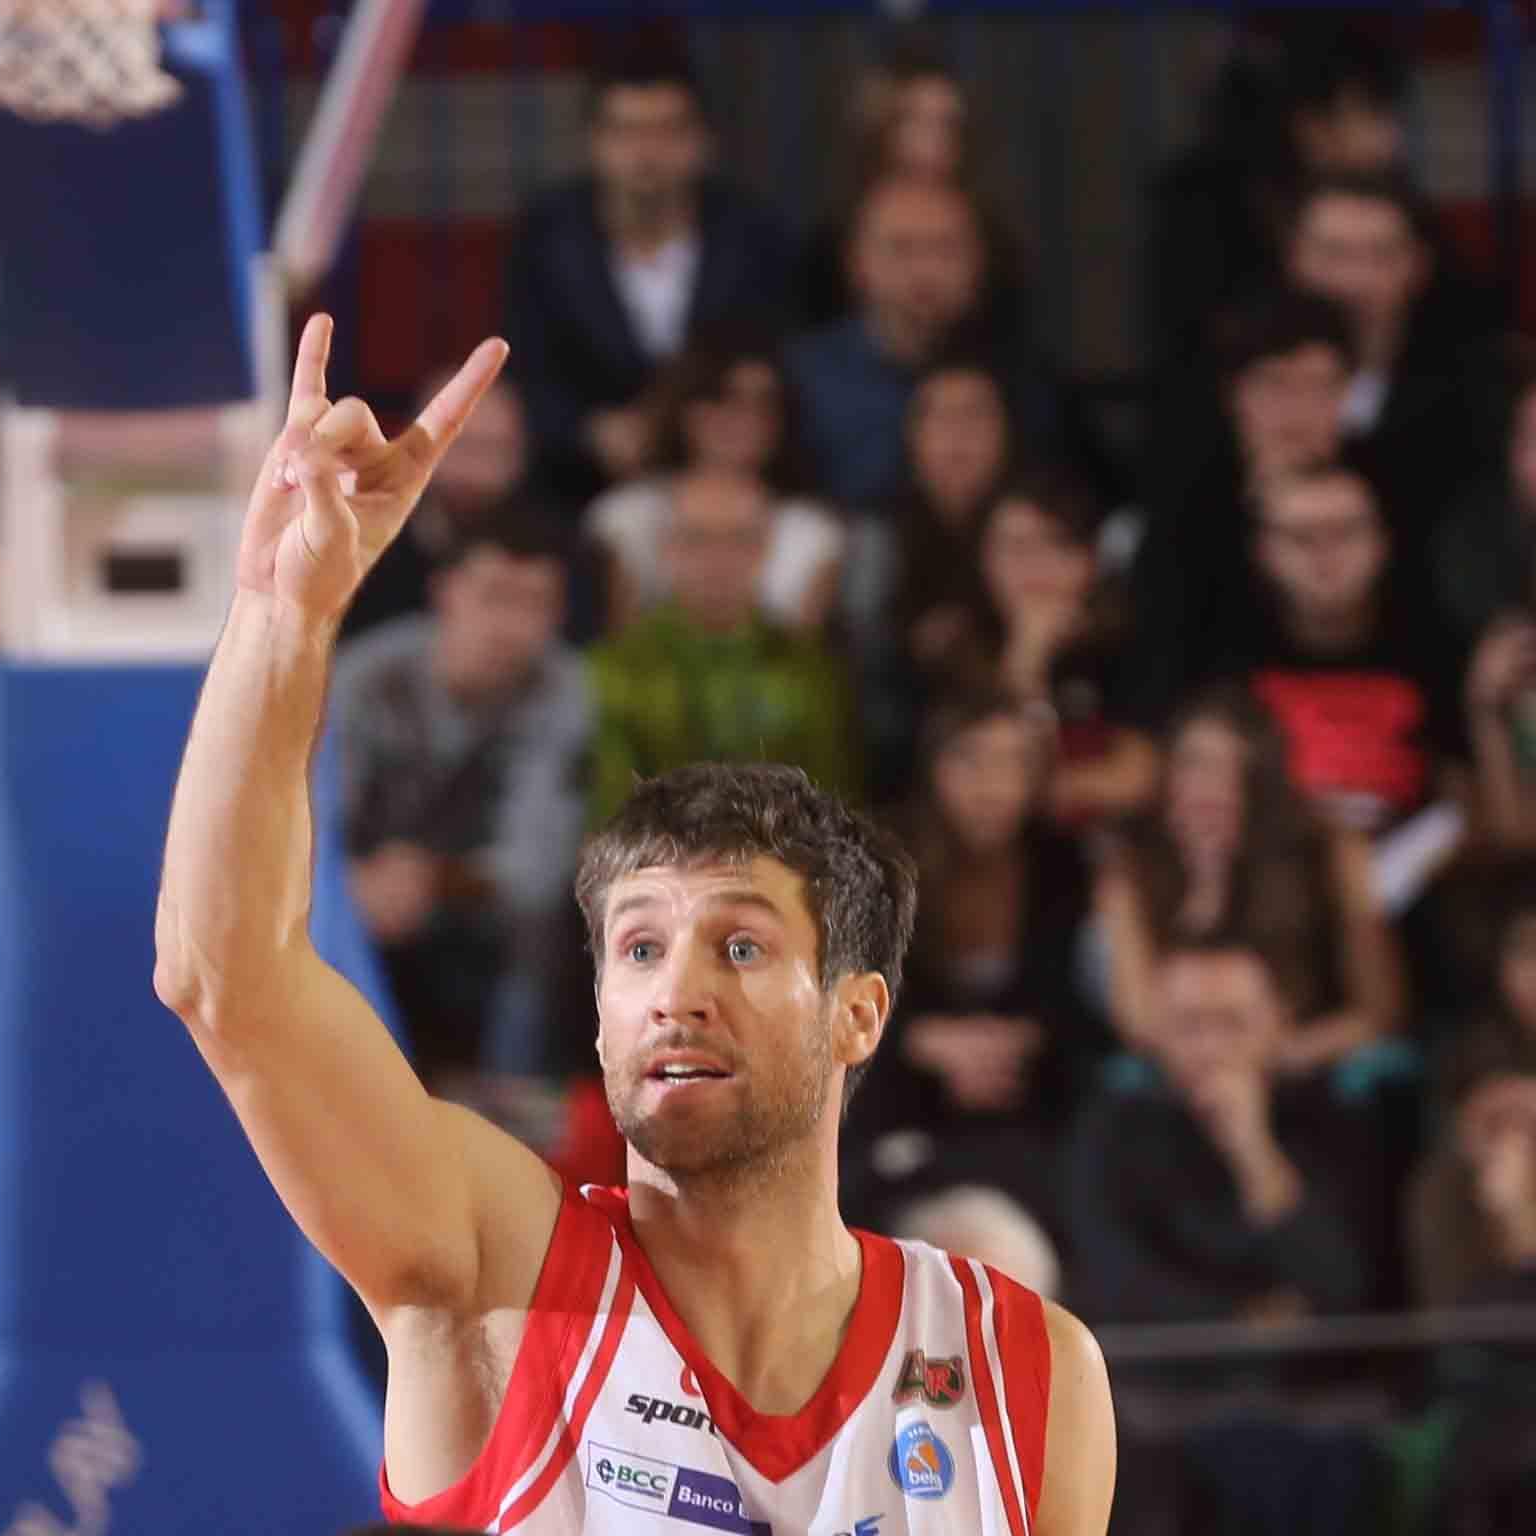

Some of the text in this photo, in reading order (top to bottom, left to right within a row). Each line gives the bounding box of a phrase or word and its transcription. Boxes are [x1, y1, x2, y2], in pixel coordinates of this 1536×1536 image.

[625, 1393, 718, 1435] spor
[617, 1464, 669, 1491] BCC
[677, 1485, 734, 1514] Banco
